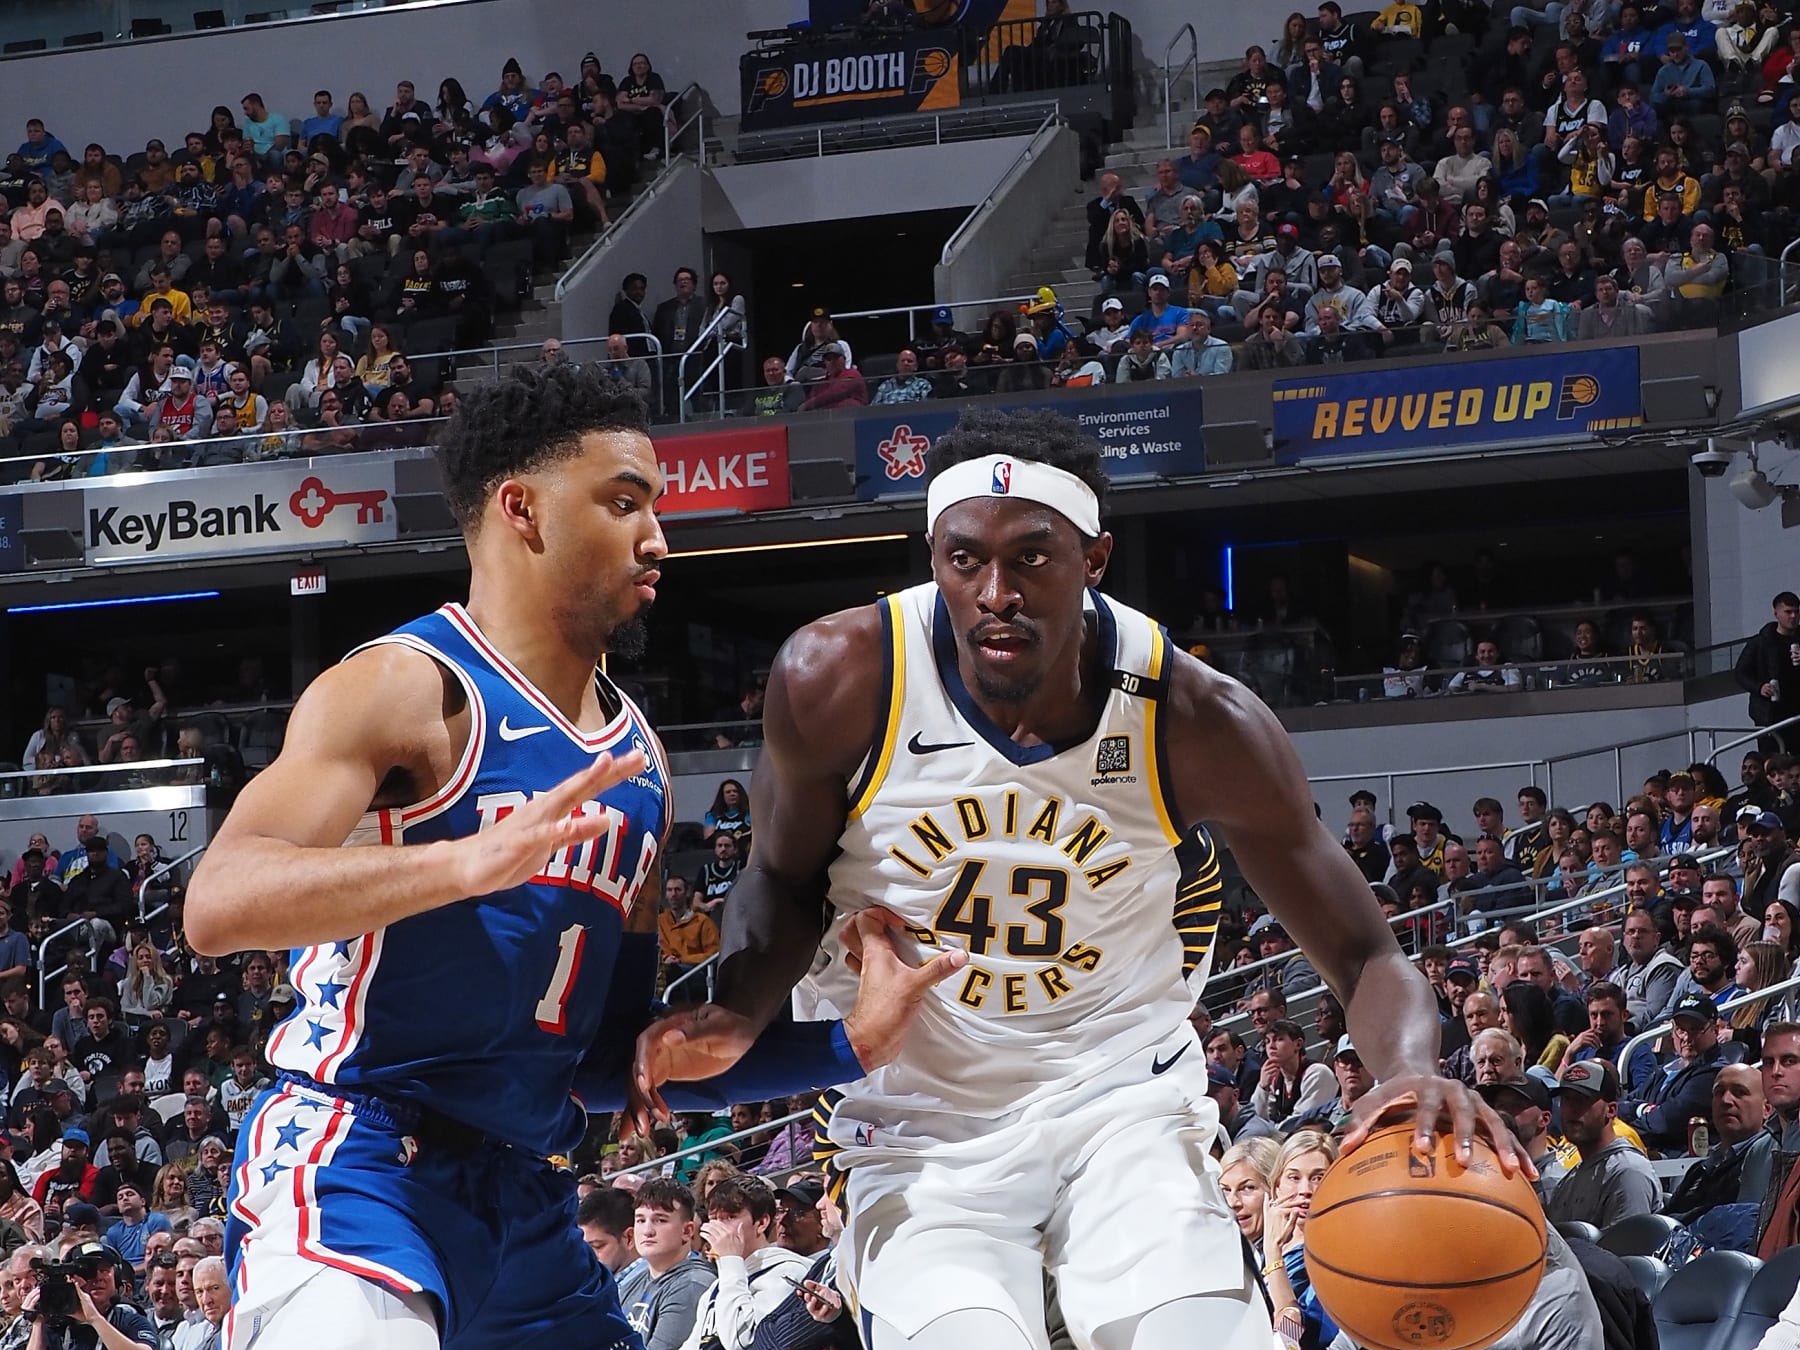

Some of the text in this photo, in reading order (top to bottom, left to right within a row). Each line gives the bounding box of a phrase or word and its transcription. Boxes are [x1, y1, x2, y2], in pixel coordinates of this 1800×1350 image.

[793, 51, 905, 98] DJ BOOTH
[1078, 406, 1170, 426] Environmental
[1098, 424, 1151, 439] Services
[1312, 382, 1553, 440] REVVED UP
[1100, 441, 1182, 459] ling & Waste
[659, 452, 769, 496] HAKE
[89, 494, 281, 551] KeyBank
[297, 574, 320, 590] EXIT
[1120, 673, 1140, 694] 30
[1091, 774, 1137, 787] spokenote
[169, 811, 188, 842] 12
[889, 790, 1132, 890] INDIANA
[933, 858, 1071, 957] 43
[535, 923, 586, 1036] 1
[904, 925, 1103, 1014] PCERS
